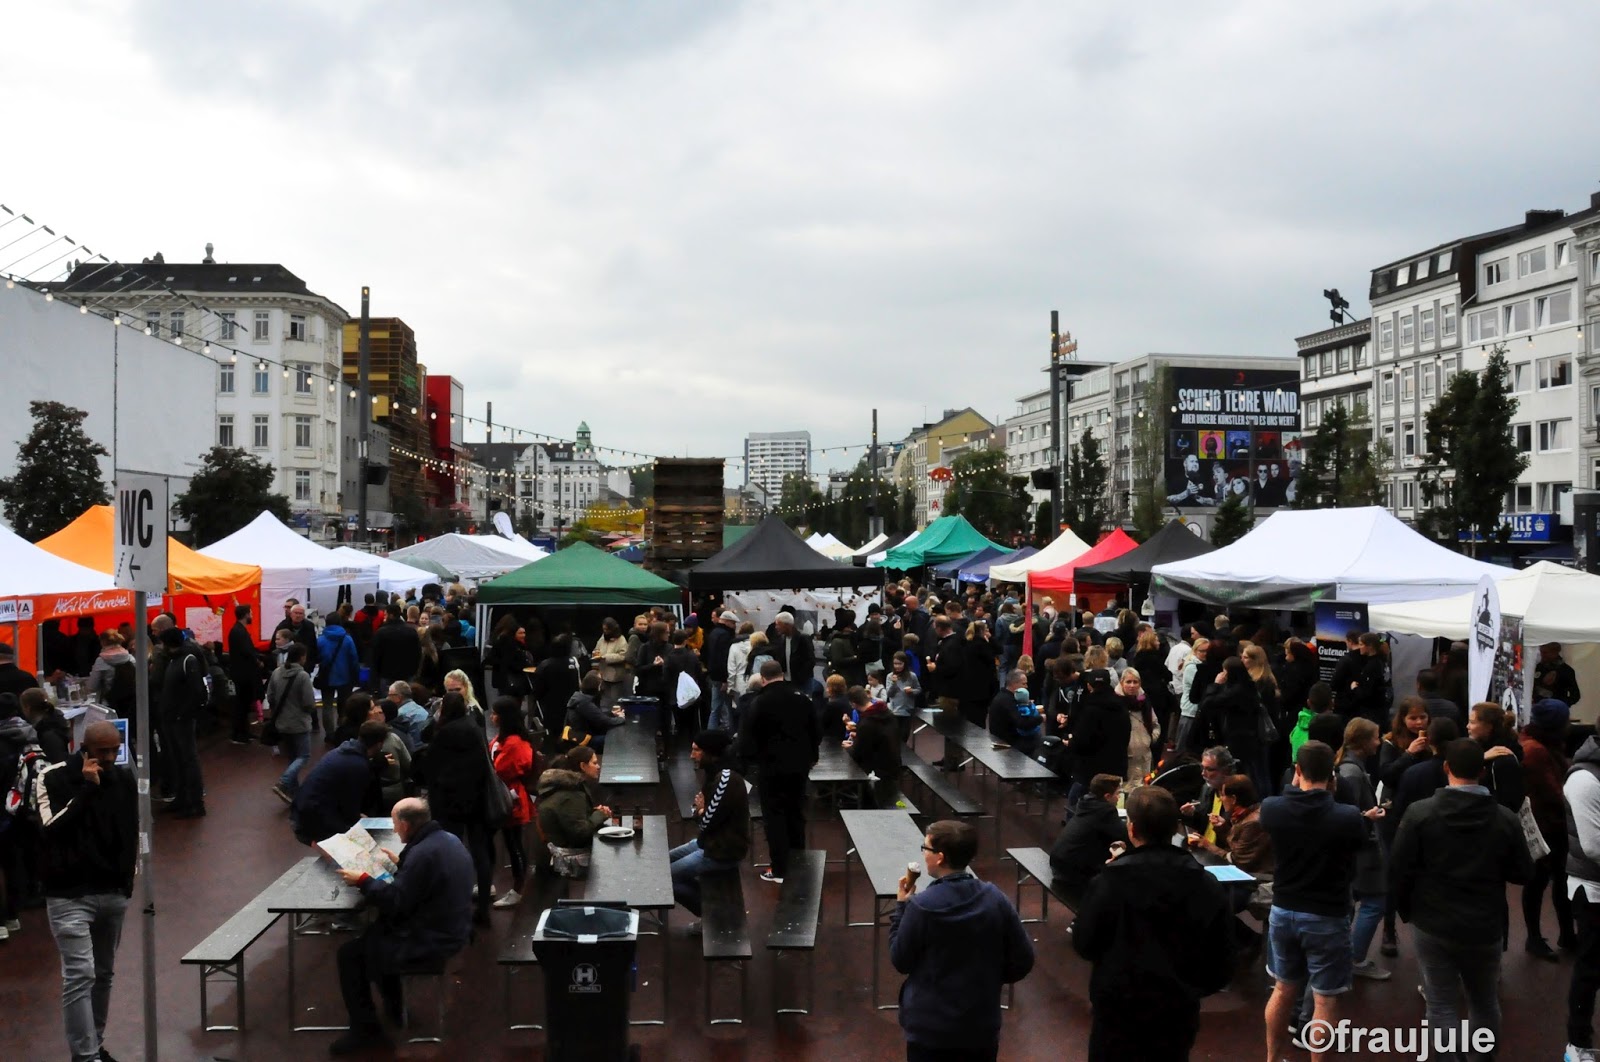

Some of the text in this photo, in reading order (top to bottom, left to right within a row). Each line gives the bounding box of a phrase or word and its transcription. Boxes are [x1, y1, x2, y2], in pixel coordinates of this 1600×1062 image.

[1224, 389, 1261, 413] TEURE
[1263, 390, 1301, 415] WAND,
[1181, 413, 1196, 424] ABER
[1196, 413, 1217, 425] UNSERE
[1217, 412, 1245, 425] KÜNSTLER
[1259, 415, 1267, 426] ES
[1266, 415, 1278, 426] UNS
[1278, 416, 1295, 426] WERT!
[120, 488, 153, 548] WC
[0, 603, 16, 615] IWA
